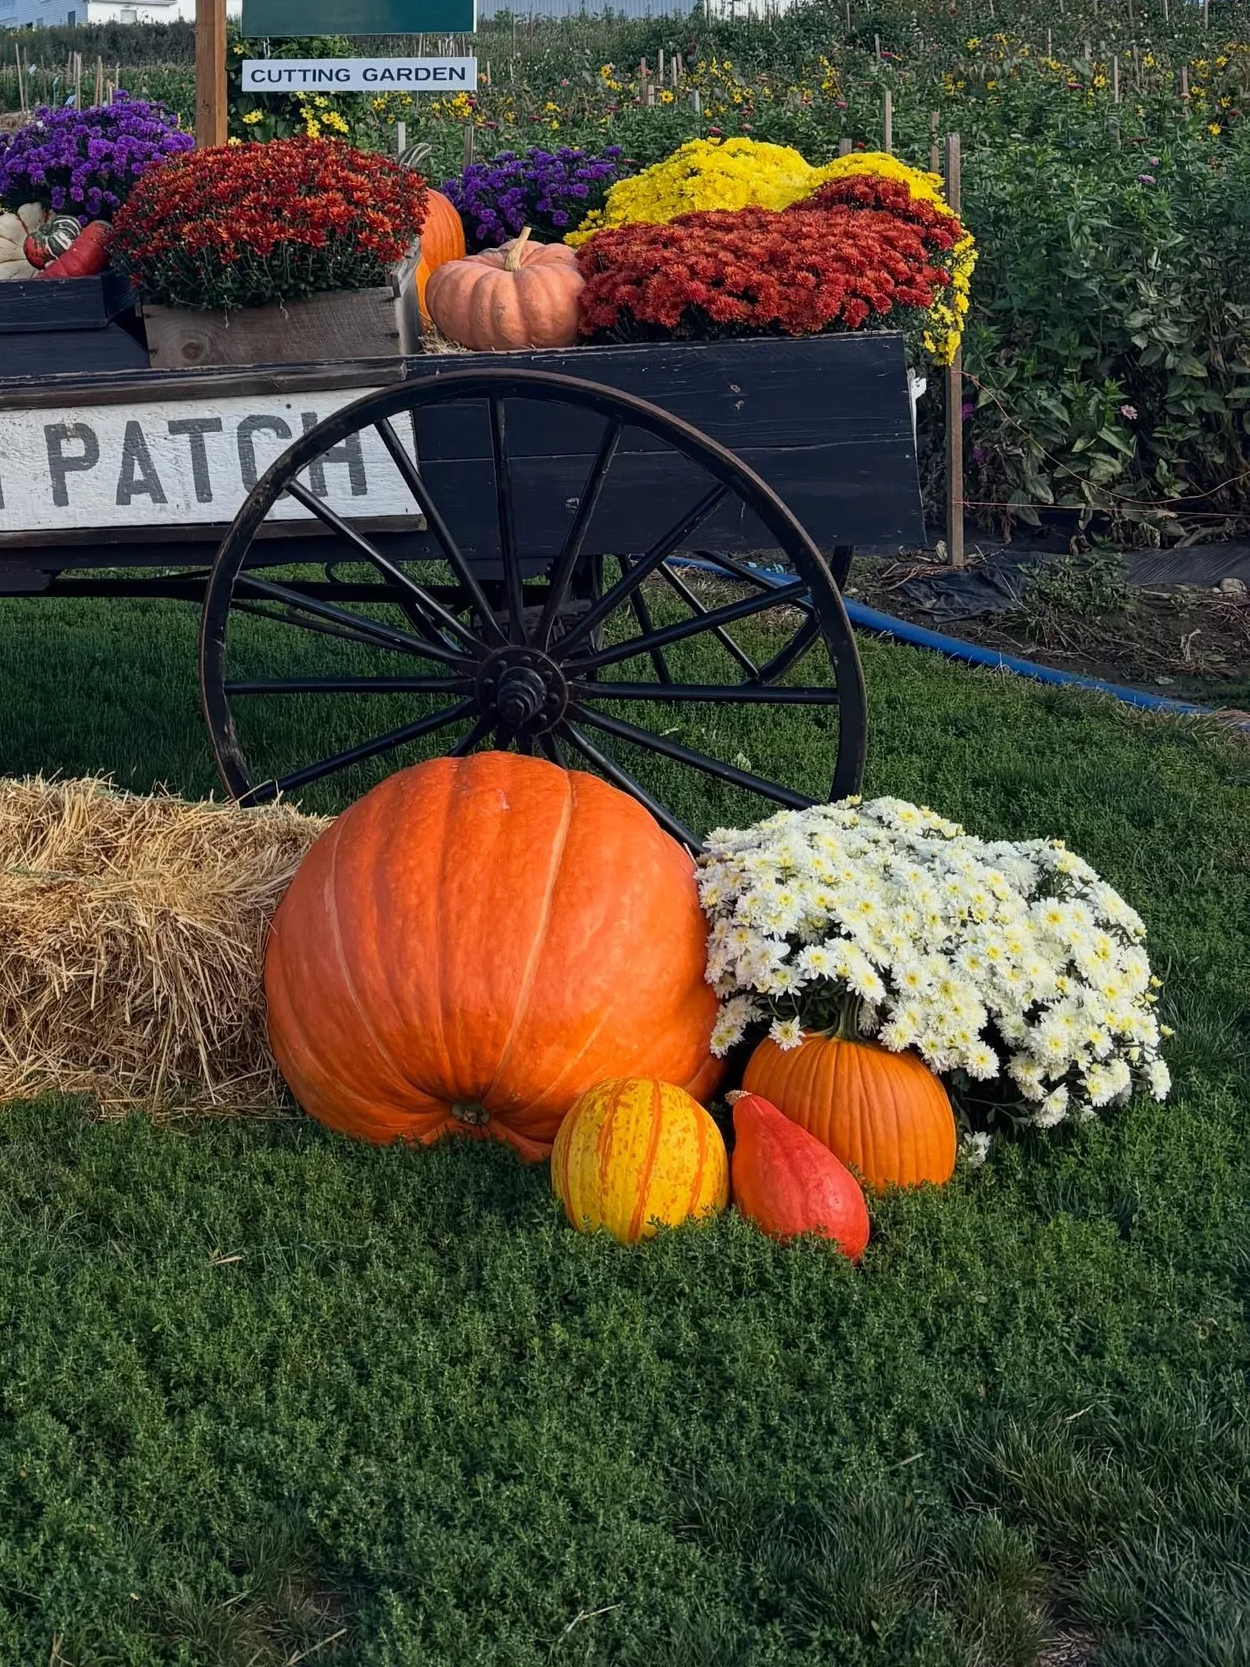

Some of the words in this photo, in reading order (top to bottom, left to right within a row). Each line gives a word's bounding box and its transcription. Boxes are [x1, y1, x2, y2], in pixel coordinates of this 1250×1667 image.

[250, 68, 350, 83] CUTTING
[362, 67, 466, 81] GARDEN
[43, 412, 367, 507] PATCH
